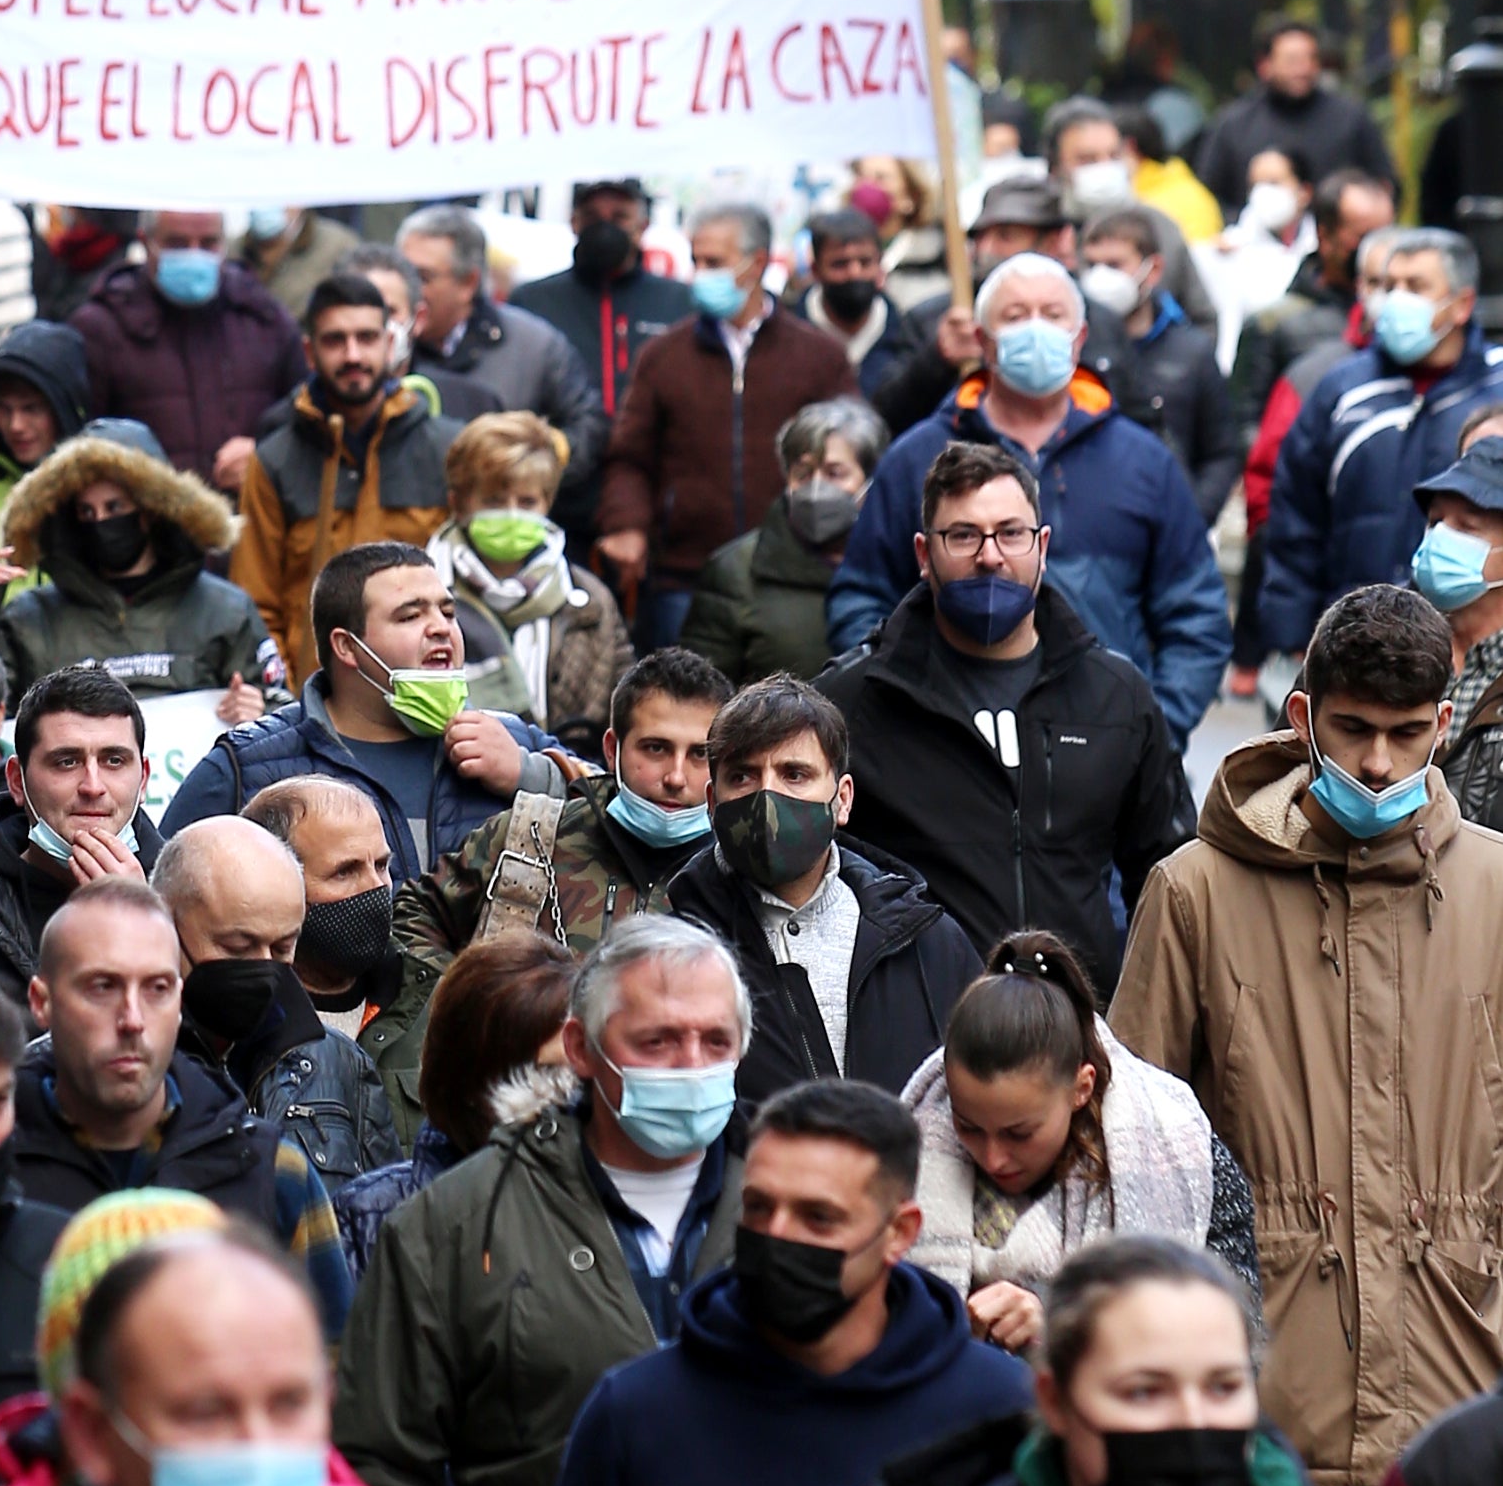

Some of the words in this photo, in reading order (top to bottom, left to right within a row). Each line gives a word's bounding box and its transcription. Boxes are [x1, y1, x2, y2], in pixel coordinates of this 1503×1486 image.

[172, 59, 351, 144] LOCAL
[386, 32, 665, 149] DISFRUTE
[690, 26, 752, 113] LA
[771, 17, 928, 104] CAZA
